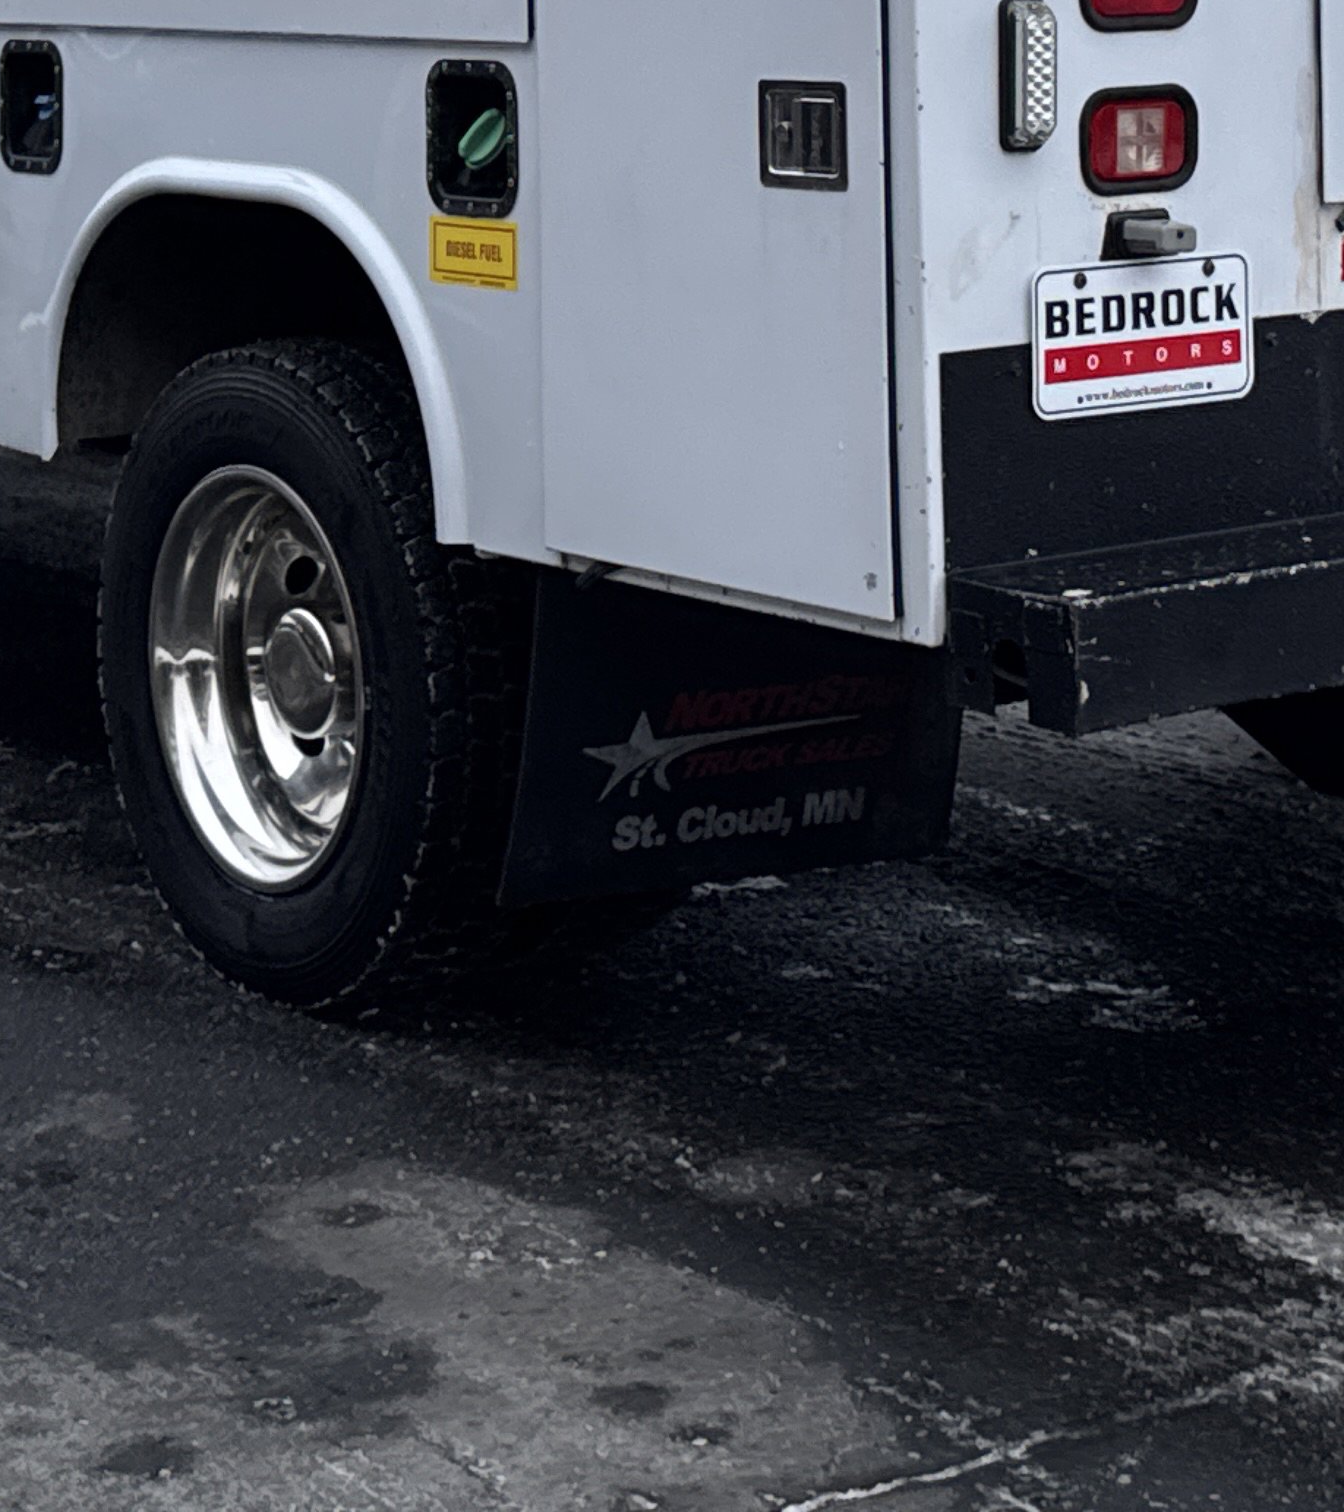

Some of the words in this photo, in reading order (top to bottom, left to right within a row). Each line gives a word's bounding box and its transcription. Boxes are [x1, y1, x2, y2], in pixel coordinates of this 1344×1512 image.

[446, 240, 477, 259] DIESEL
[479, 243, 503, 263] FUEL
[1045, 283, 1240, 339] BEDROCK
[1053, 339, 1233, 374] MOTORS
[1084, 381, 1205, 402] www.bedrockmotors.com
[664, 672, 912, 733] NORTHSTAR
[682, 742, 793, 780] TRUCK
[794, 731, 897, 765] SALES
[611, 813, 668, 852] St.
[676, 796, 794, 844] Cloud,
[801, 786, 866, 828] MN
